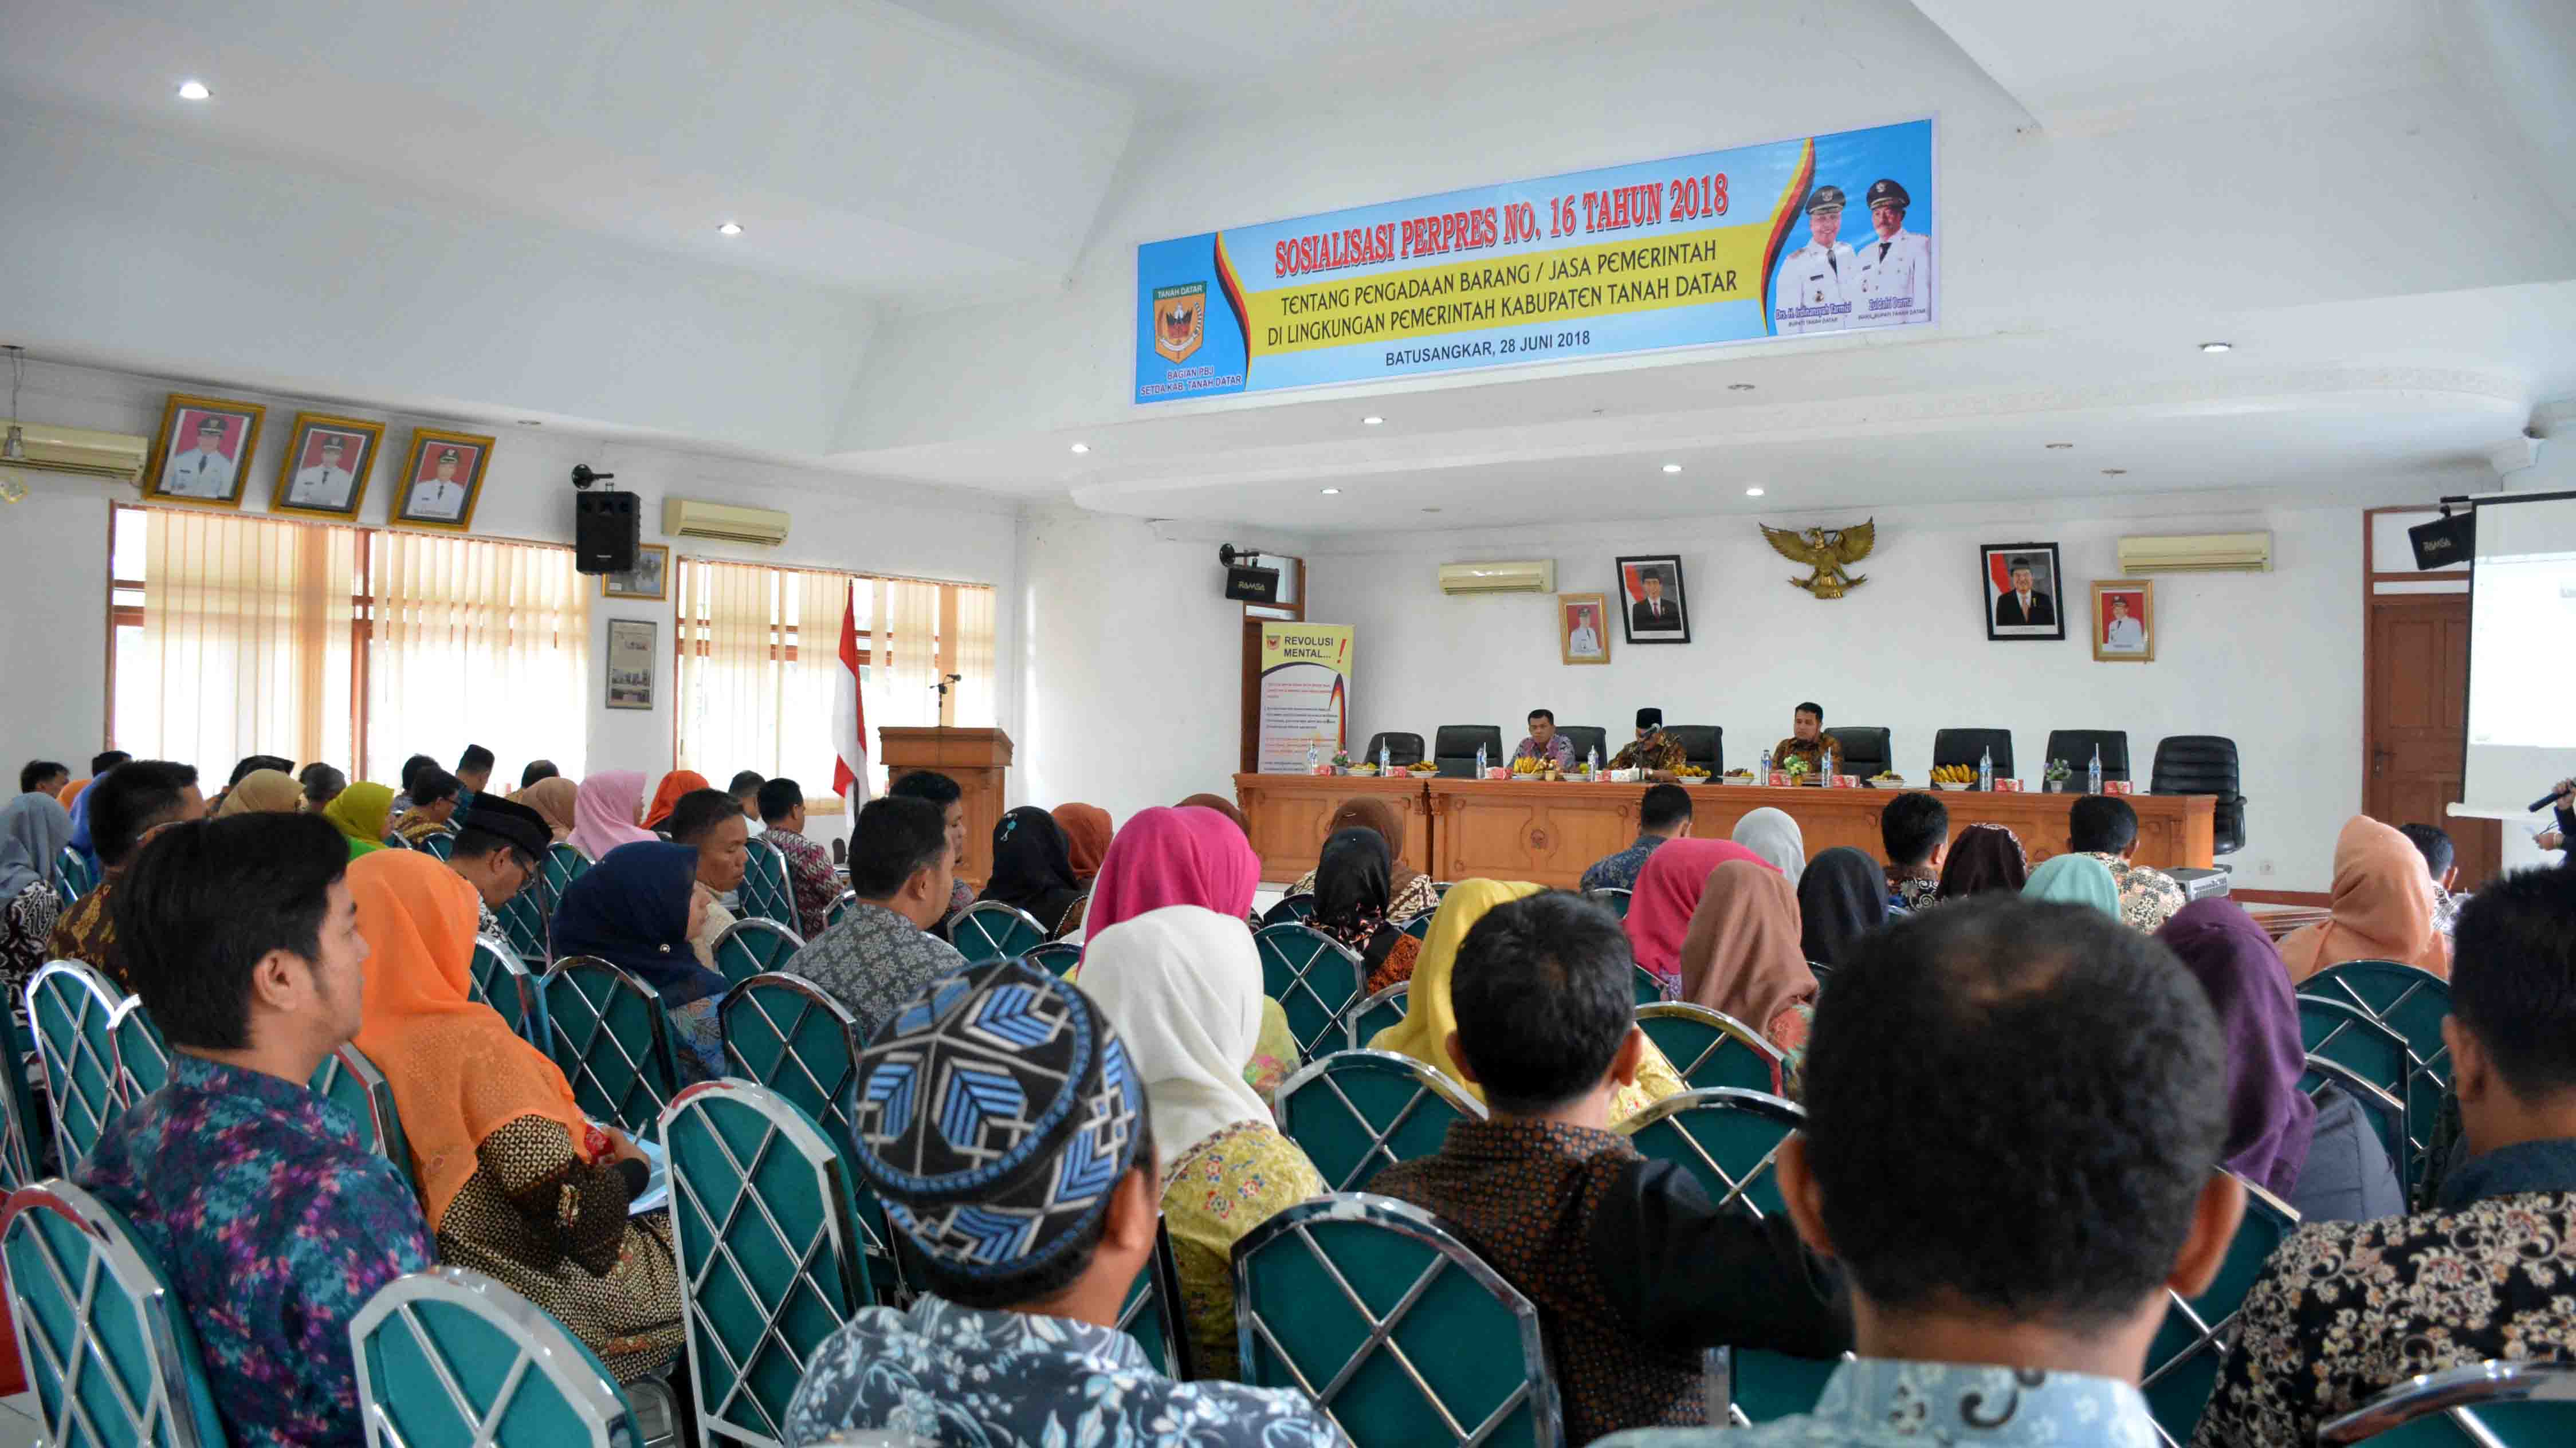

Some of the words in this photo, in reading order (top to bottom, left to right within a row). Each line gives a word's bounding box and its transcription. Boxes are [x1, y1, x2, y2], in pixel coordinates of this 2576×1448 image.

[1275, 223, 1395, 278] SOSIALISASI
[1400, 206, 1497, 259] PERPRES
[1503, 201, 1541, 245] NO.
[1550, 195, 1576, 238] 16
[1582, 183, 1663, 233] TAHUN
[1670, 173, 1729, 222] 2018
[1157, 288, 1180, 298] TANAH
[1181, 285, 1203, 294] DATAR
[1281, 288, 1349, 316] TENTANG
[1354, 274, 1454, 306] PENGADAAN
[1460, 264, 1530, 292] BARANG
[1536, 262, 1544, 282] /
[1549, 257, 1591, 281] JASA
[1598, 239, 1716, 274] PEMERINTAH
[1268, 326, 1282, 346] DI
[1287, 313, 1385, 344] LINGKUNGAN
[1391, 299, 1495, 330] PEMERINTAH
[1502, 285, 1602, 317] KABUPATEN
[1607, 278, 1668, 305] TANAH
[1676, 270, 1737, 297] DATAR
[1386, 341, 1495, 366] BATUSANGKAR,
[1501, 339, 1515, 353] 28
[1520, 334, 1553, 352] JUNI
[1558, 330, 1590, 347] 2018
[1141, 384, 1165, 396] SETDA
[1187, 379, 1214, 390] TANAH
[1215, 375, 1242, 386] DATAR
[1167, 369, 1197, 380] BAGIAN
[1199, 367, 1214, 377] PBJ
[1284, 636, 1334, 647] REVOLUSI
